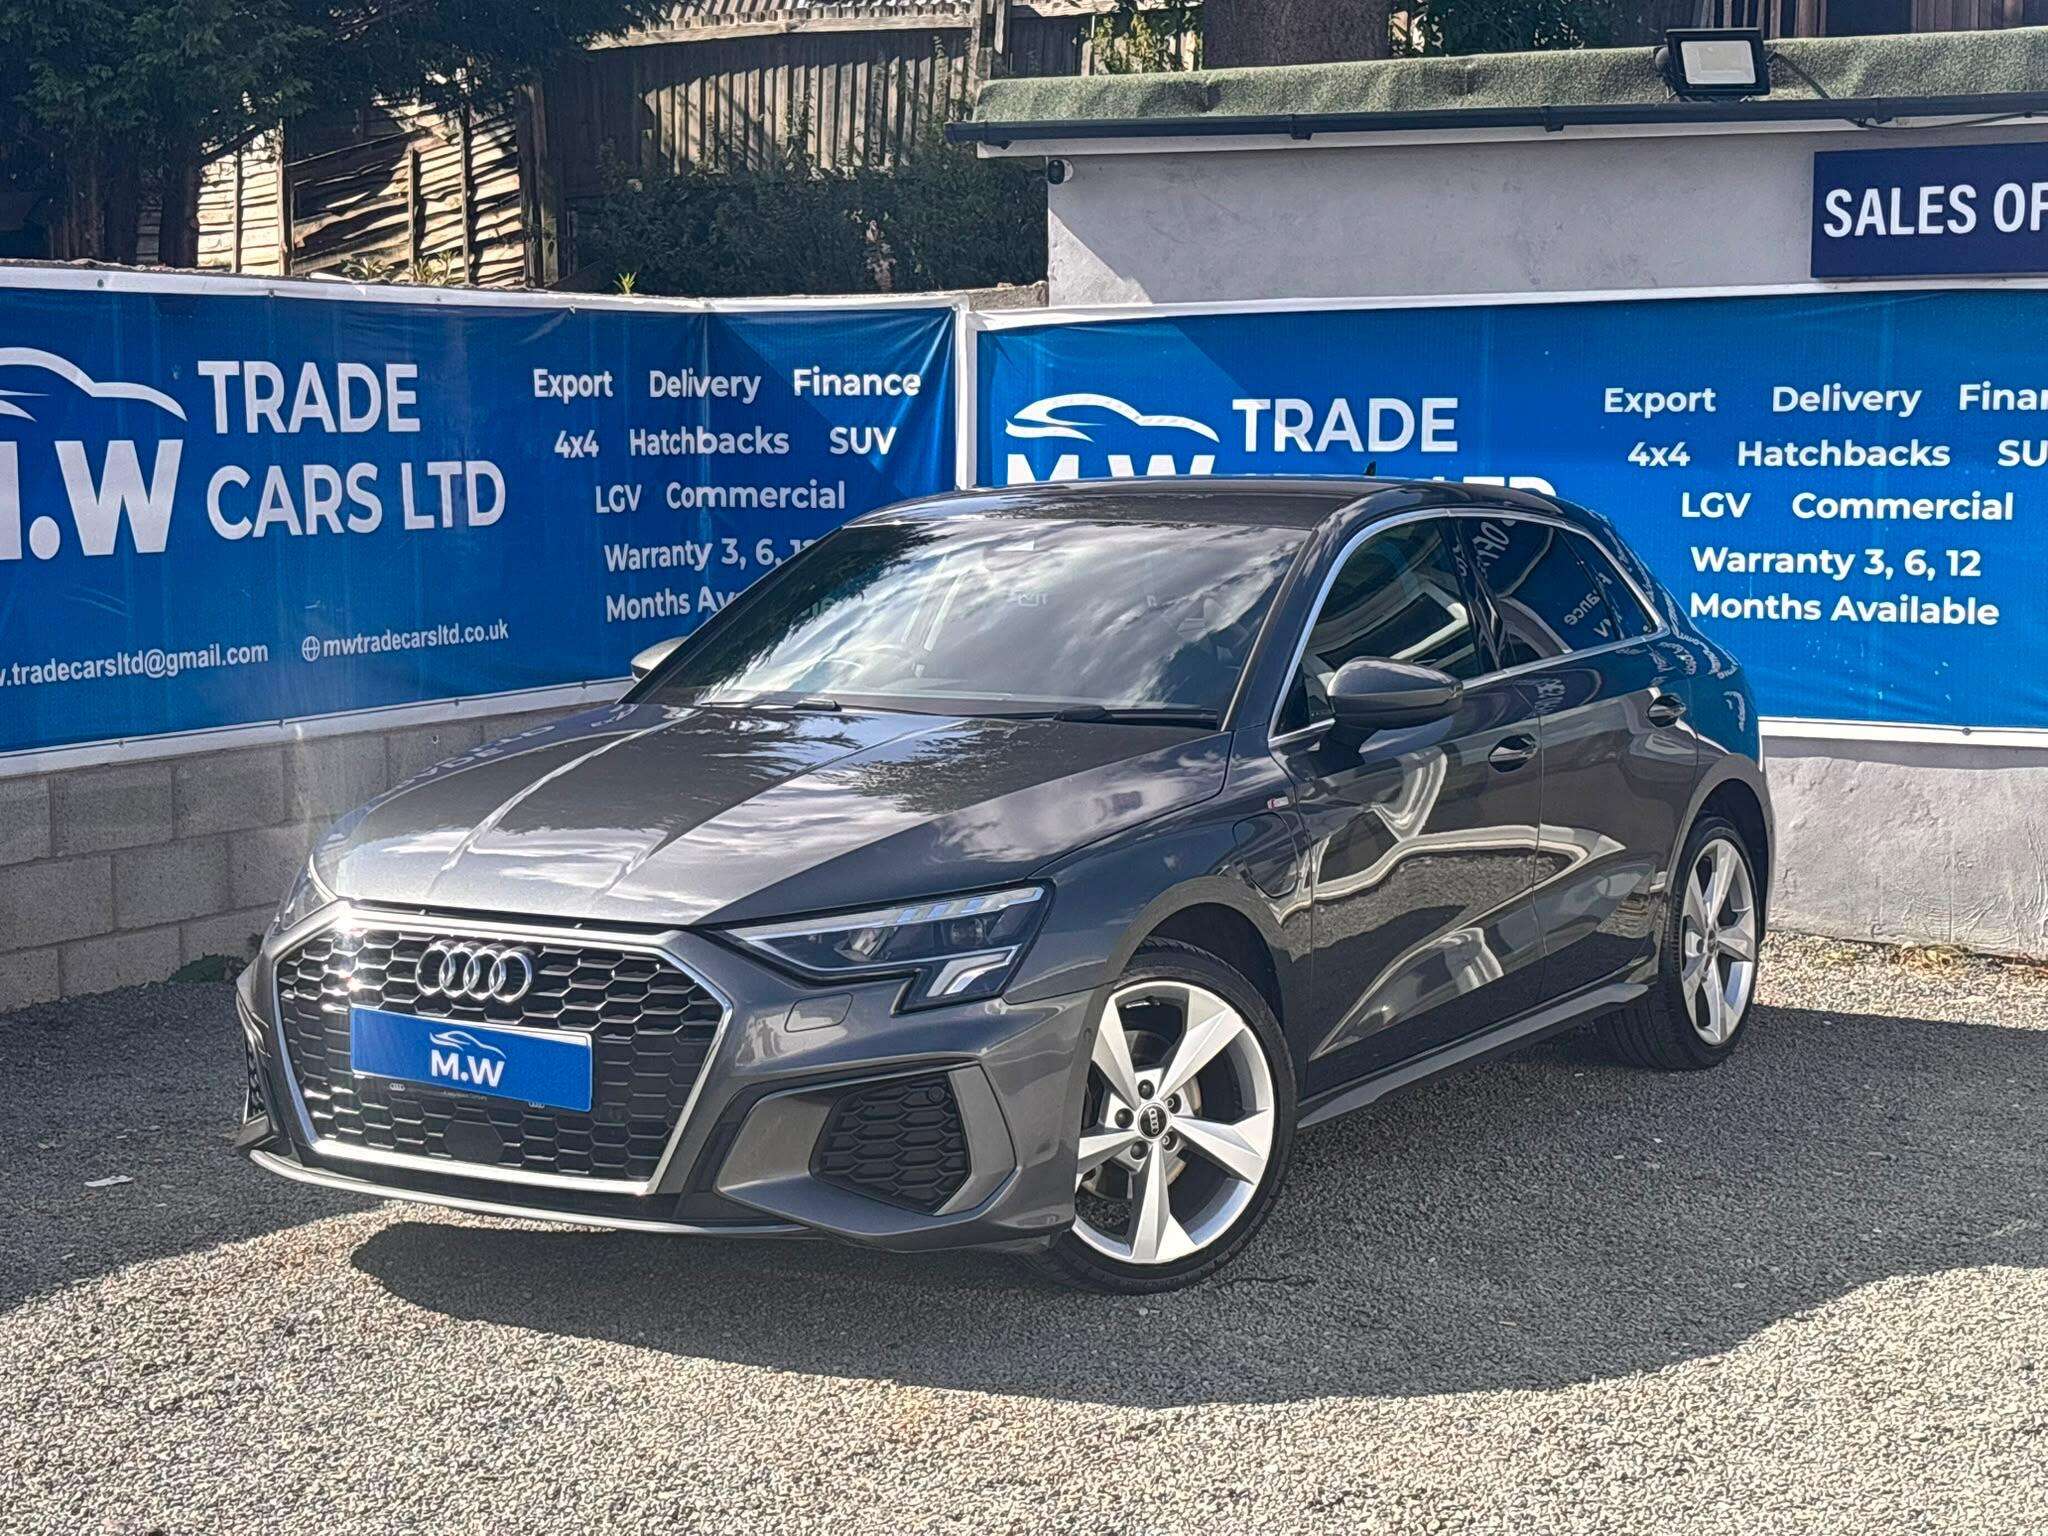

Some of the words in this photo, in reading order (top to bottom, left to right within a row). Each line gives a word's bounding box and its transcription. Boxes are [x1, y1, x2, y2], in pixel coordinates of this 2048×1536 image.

[1823, 184, 1977, 238] SALES
[198, 360, 421, 434] TRADE
[533, 368, 613, 404] Export
[649, 368, 761, 404] Delivery
[794, 365, 921, 397] Finance
[1604, 387, 1717, 419] Export
[1772, 383, 1922, 418] Delivery
[554, 429, 599, 459] 4x4
[629, 425, 790, 456] Hatchbacks
[829, 426, 897, 455] SUV
[1232, 397, 1458, 453] TRADE
[1627, 441, 1691, 467] 4x4
[1738, 439, 1951, 467] Hatchbacks
[206, 462, 383, 541] CARS
[401, 460, 506, 531] LTD
[595, 484, 642, 514] LGV
[666, 479, 845, 510] Commercial
[1681, 491, 1751, 518] LGV
[1792, 490, 2014, 521] Commercial
[603, 539, 713, 572] Warranty
[721, 538, 747, 570] 3,
[1690, 546, 1856, 581] Warranty
[1863, 548, 1894, 580] 3,
[1904, 549, 1936, 581] 6,
[1945, 549, 1982, 577] 12
[606, 588, 691, 623] Months
[1690, 592, 1822, 621] Months
[1830, 593, 2000, 625] Available
[0, 643, 269, 687] .tradecarsltd@gmail.com
[323, 618, 509, 658] mwtradecarsltd.co.uk
[431, 1049, 506, 1089] M.W
